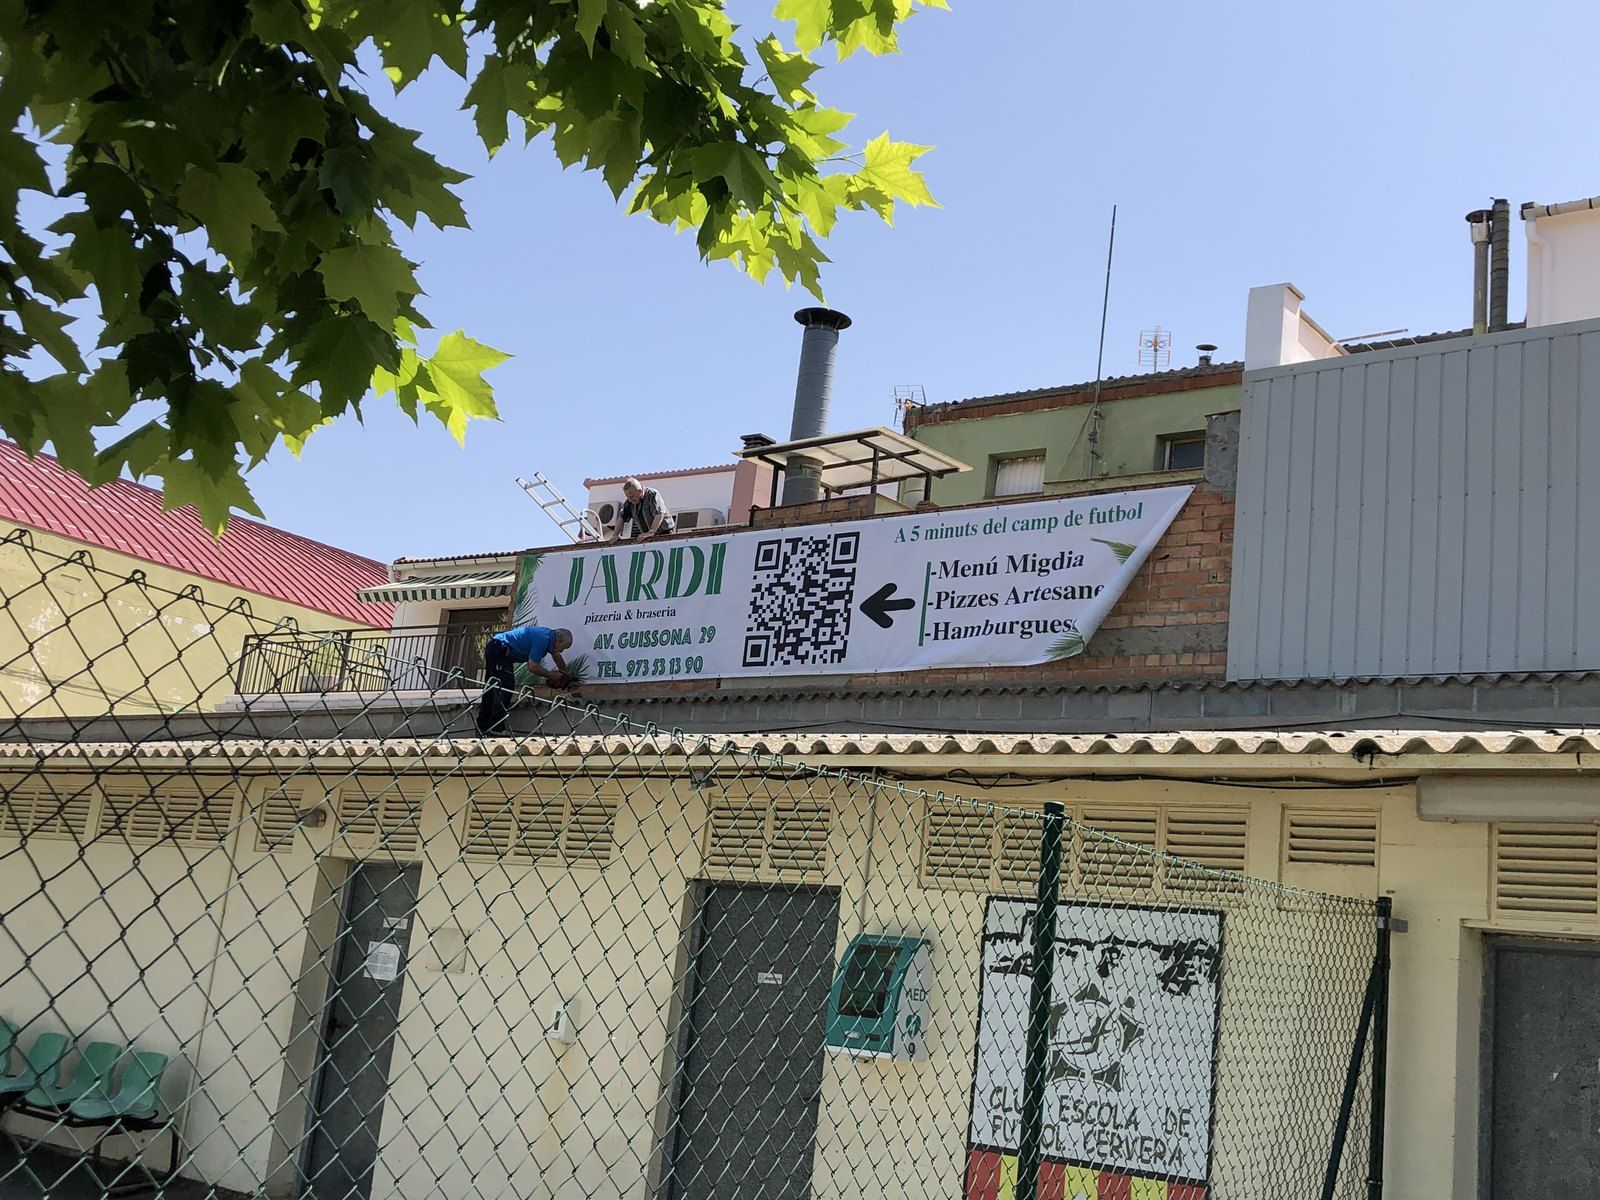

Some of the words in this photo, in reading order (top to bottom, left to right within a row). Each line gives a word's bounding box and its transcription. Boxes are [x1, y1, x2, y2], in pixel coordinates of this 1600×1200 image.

[894, 527, 906, 544] A
[910, 525, 920, 542] 5
[924, 520, 978, 541] minuts
[982, 516, 1007, 536] del
[1011, 515, 1059, 535] camp
[1063, 509, 1084, 528] de
[1088, 502, 1143, 525] futbol
[552, 542, 728, 607] JARDI
[1004, 550, 1085, 578] Migdia
[584, 609, 622, 625] pizzeria
[624, 609, 633, 620] &
[636, 606, 676, 620] braseria
[593, 633, 614, 650] AV.
[618, 627, 692, 649] GUISSONA
[698, 625, 716, 645] 29
[924, 618, 1080, 642] -Hamburgues
[597, 660, 622, 678] TEL.
[626, 658, 650, 677] 973
[651, 657, 666, 676] 53
[668, 656, 681, 675] 13
[685, 655, 704, 674] 90
[990, 1086, 1024, 1114] CLU
[1059, 1095, 1140, 1132] ESCOLA
[1163, 1107, 1192, 1138] DE
